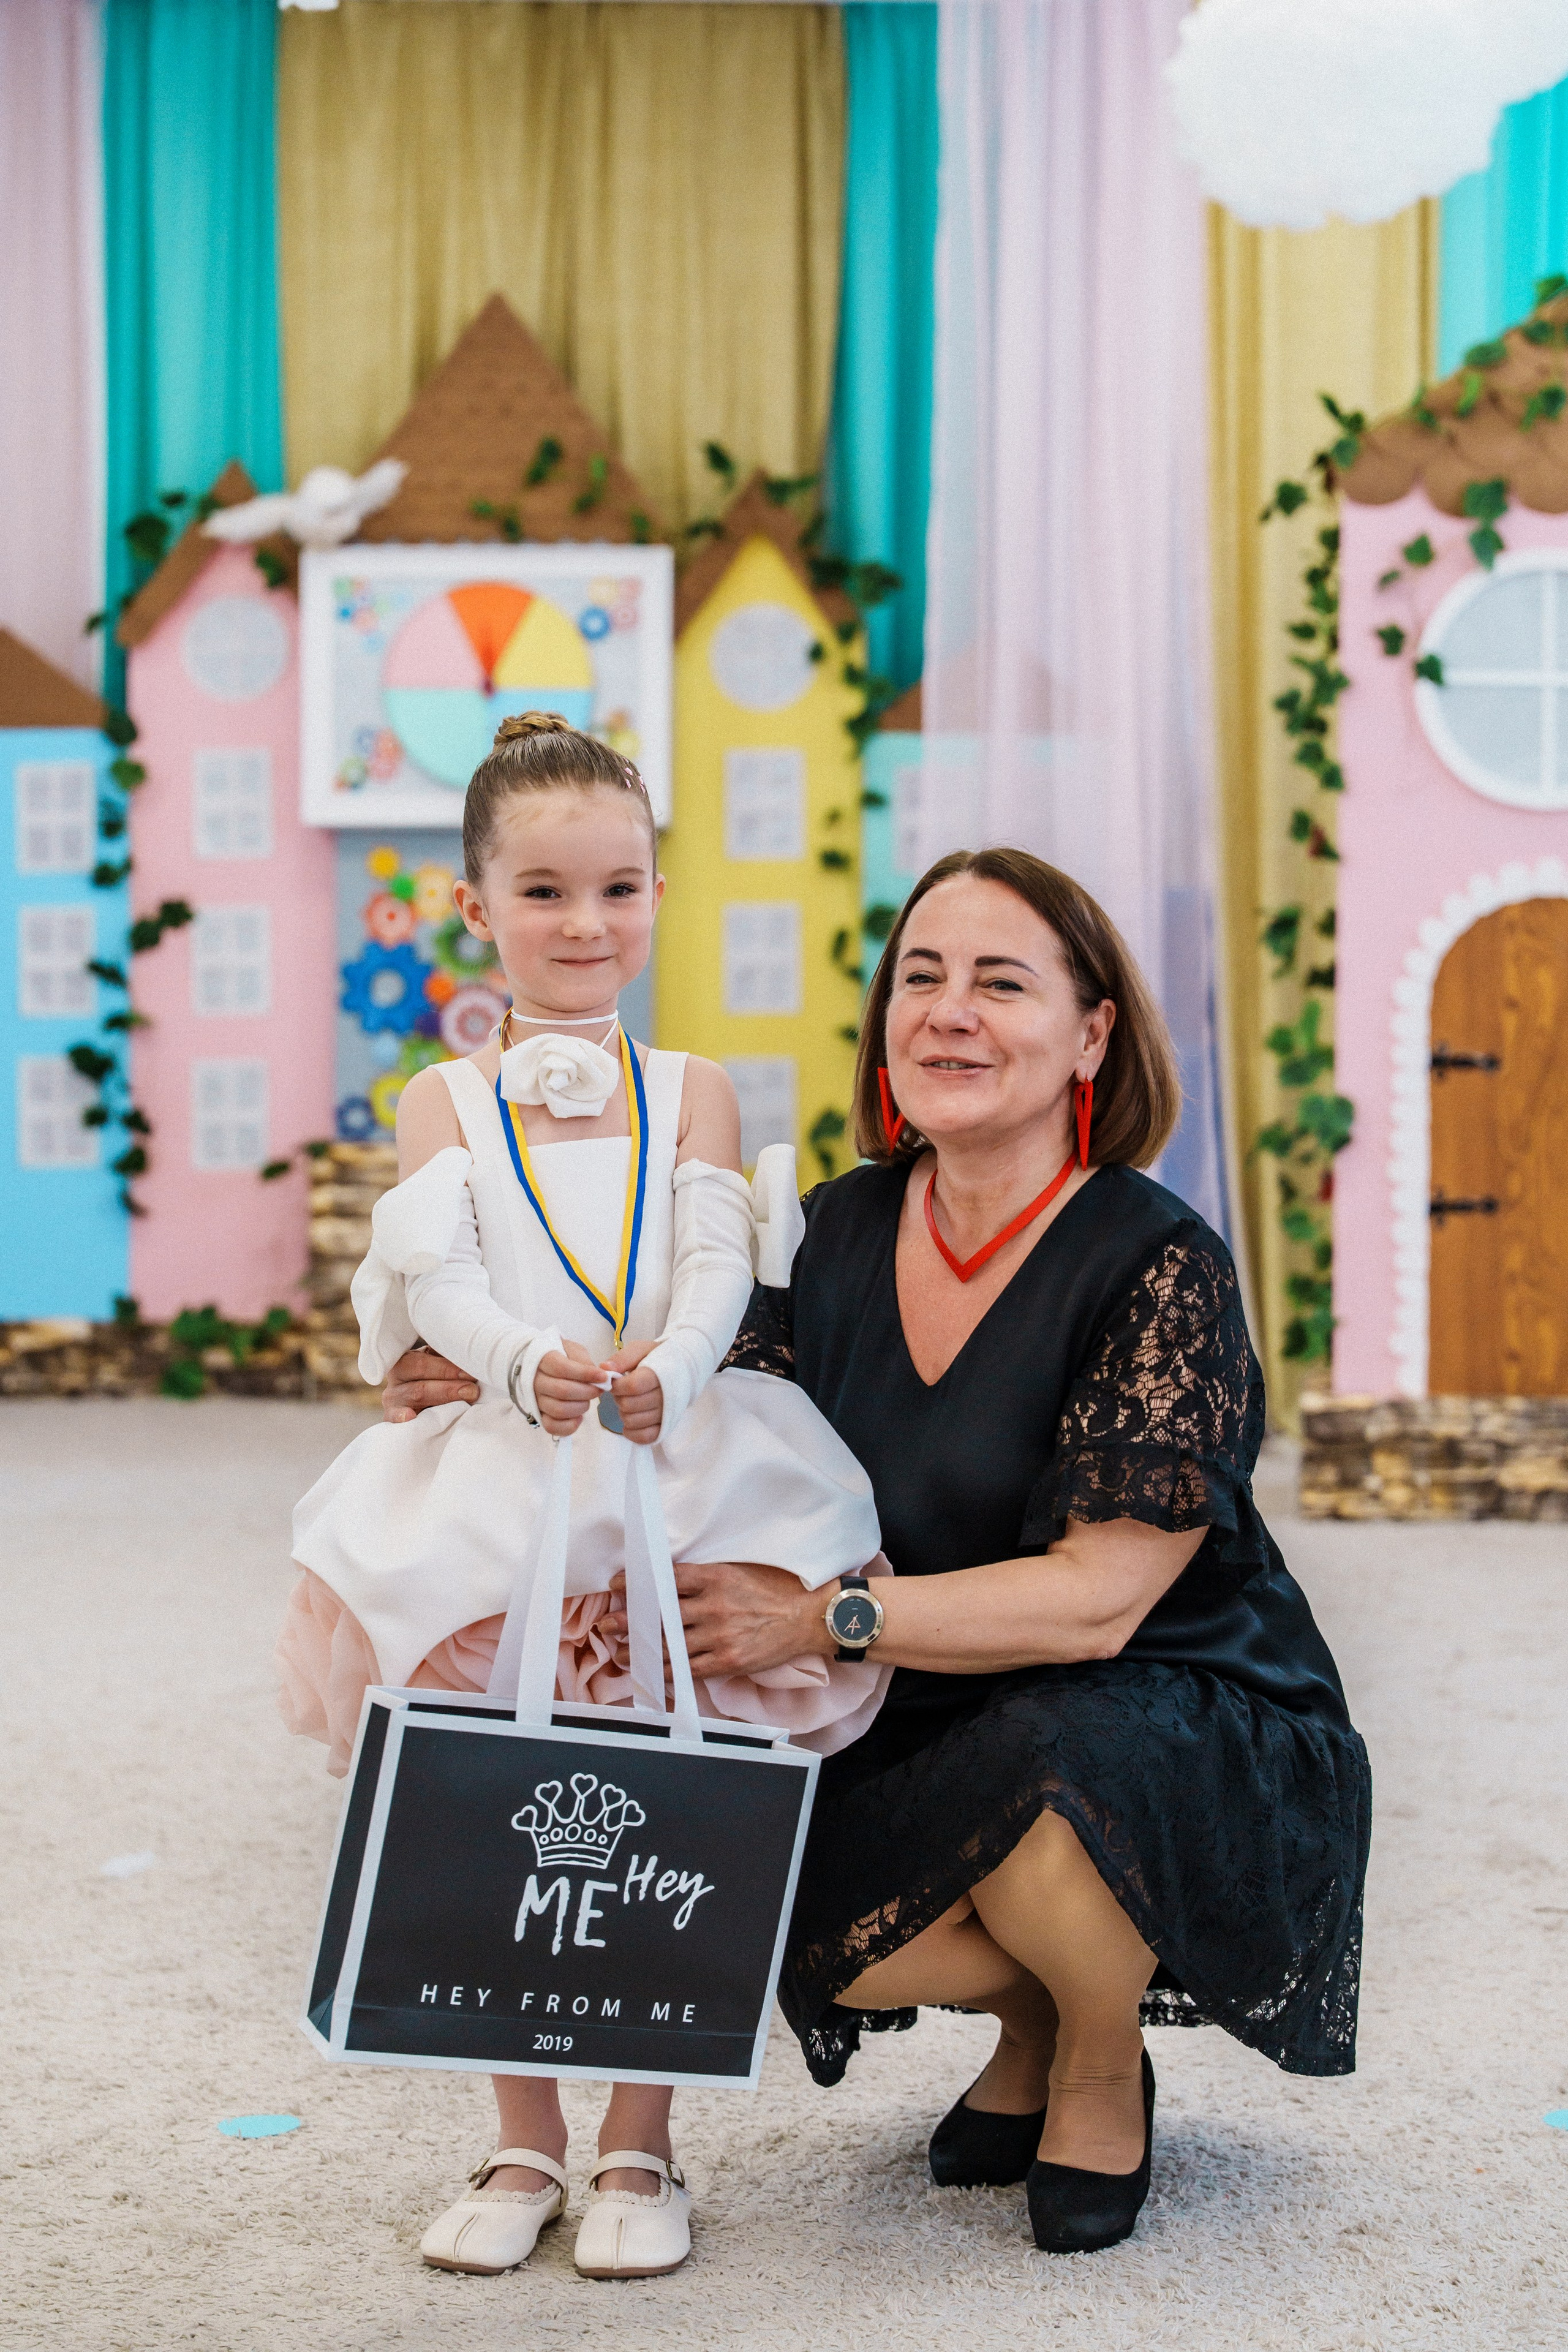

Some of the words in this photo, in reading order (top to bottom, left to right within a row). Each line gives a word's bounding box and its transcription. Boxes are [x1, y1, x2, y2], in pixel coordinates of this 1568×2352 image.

[513, 1873, 619, 1956] ME
[622, 1853, 715, 1931] Hey
[420, 1983, 492, 2007] HEY
[520, 1991, 621, 2018] FROM
[650, 2001, 696, 2024] ME
[532, 2033, 574, 2052] 2019
